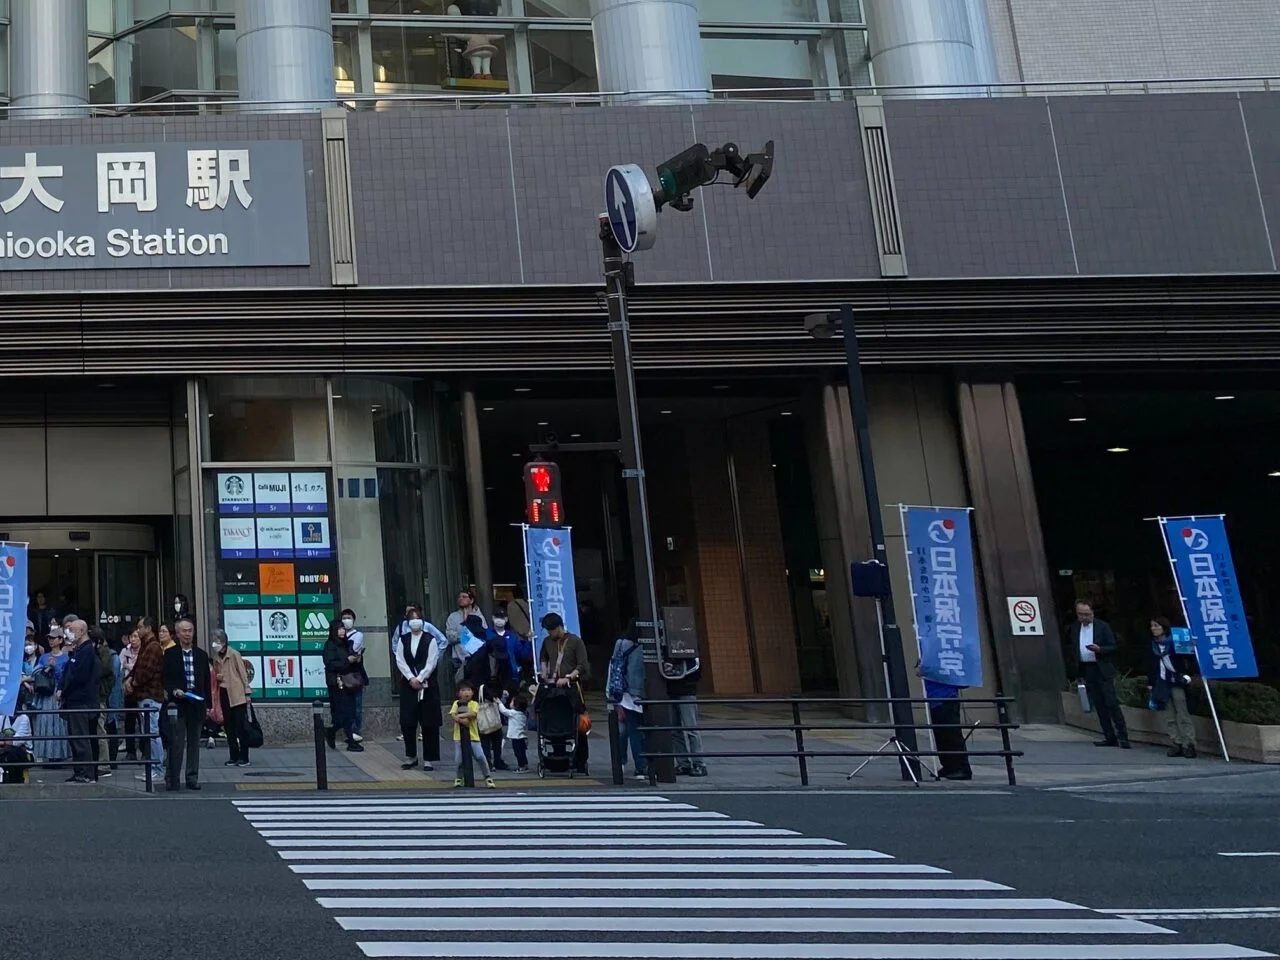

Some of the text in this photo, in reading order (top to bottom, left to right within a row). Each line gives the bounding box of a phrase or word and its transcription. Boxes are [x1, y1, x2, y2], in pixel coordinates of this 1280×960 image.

[106, 227, 229, 258] Station
[269, 484, 287, 492] MUJI
[1189, 553, 1238, 670] 日本保守党
